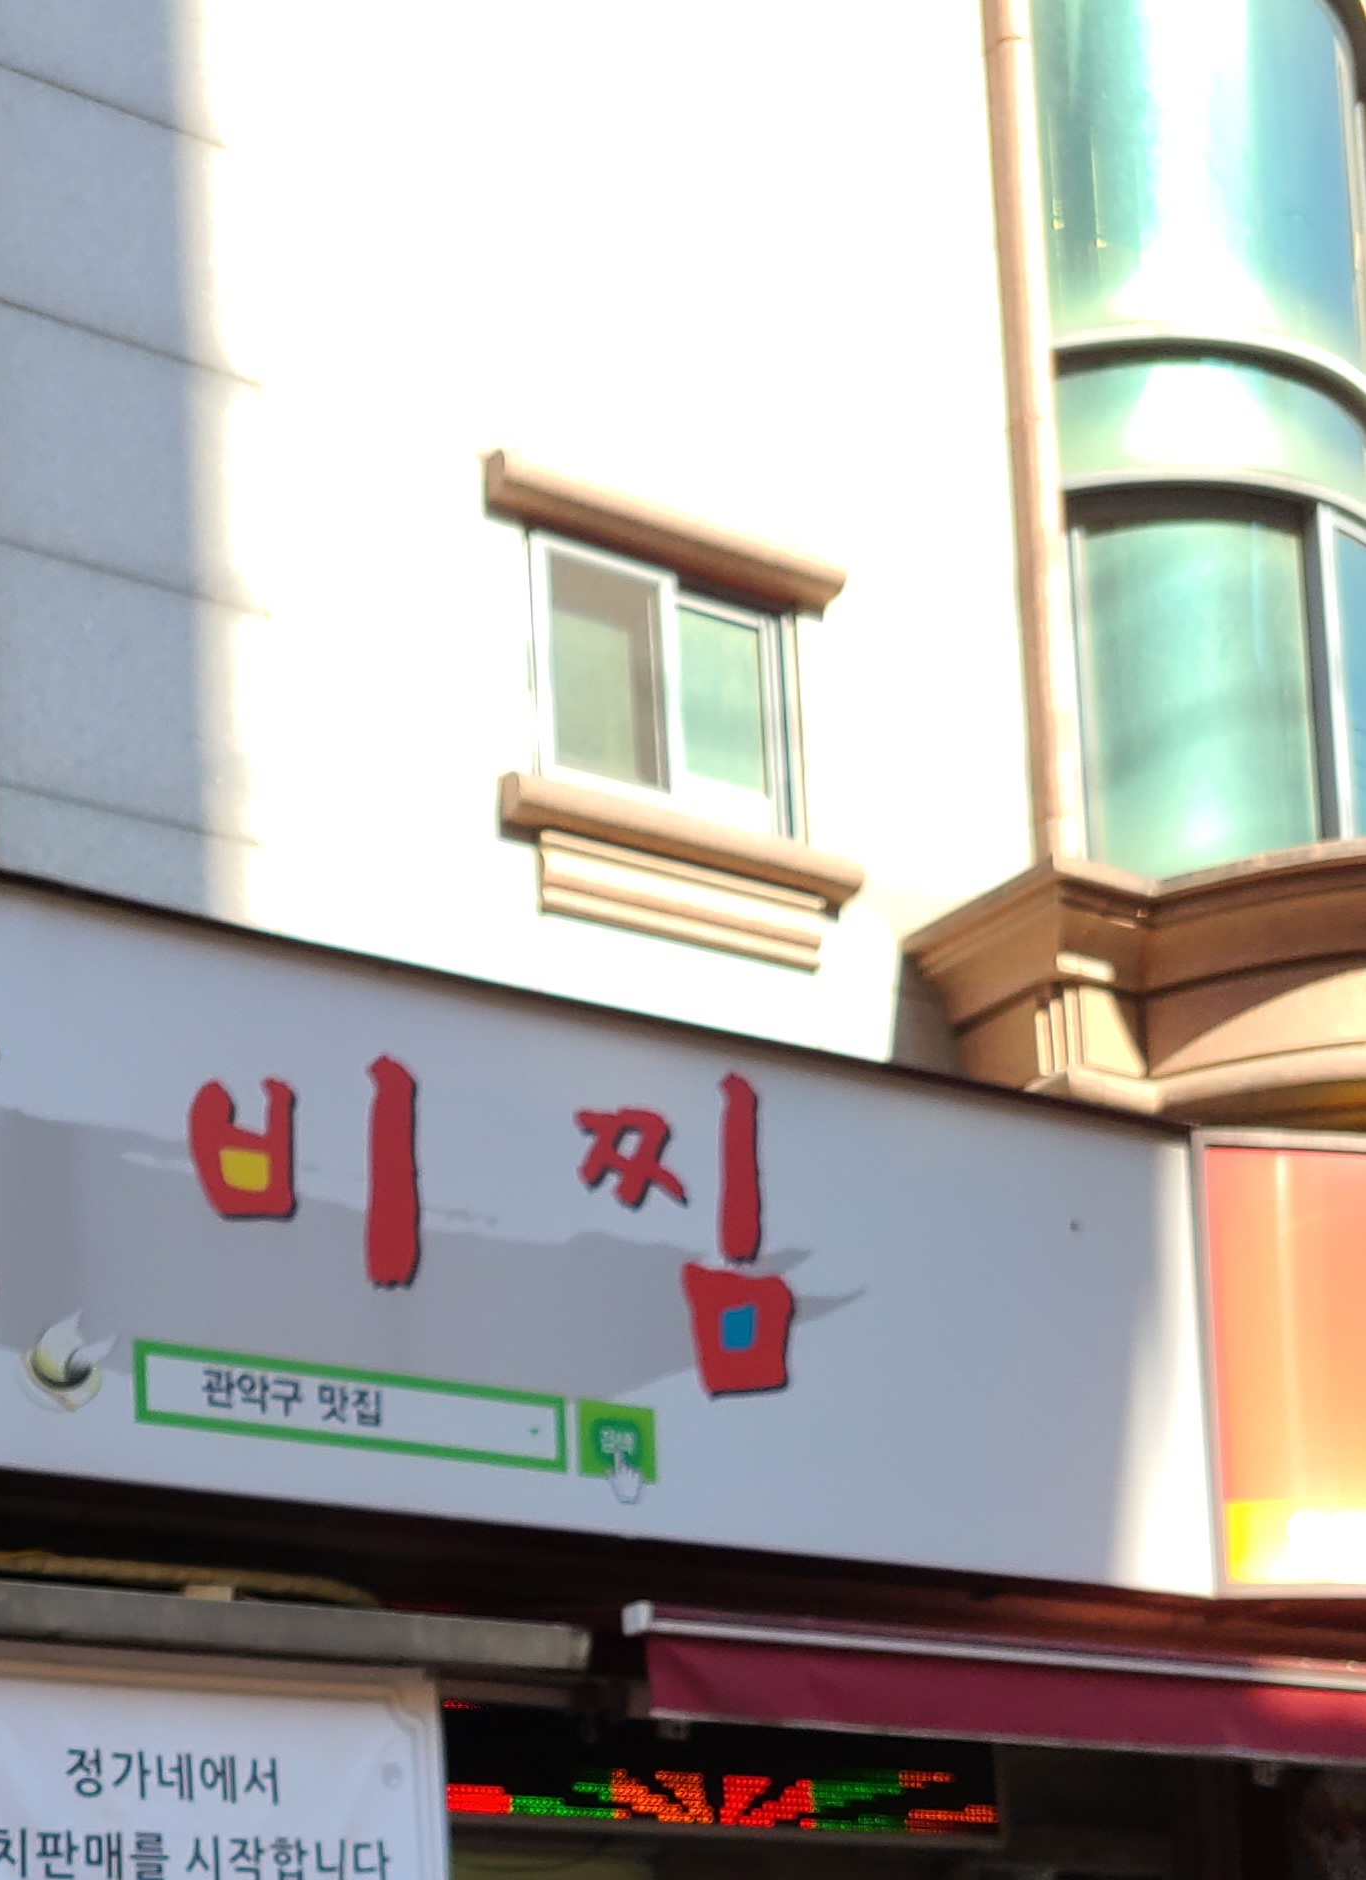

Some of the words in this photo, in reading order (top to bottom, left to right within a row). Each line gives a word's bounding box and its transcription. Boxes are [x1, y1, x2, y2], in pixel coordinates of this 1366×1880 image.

[201, 1369, 303, 1416] 관악구
[318, 1384, 383, 1428] 맛집
[65, 1747, 281, 1806] 정가네에서
